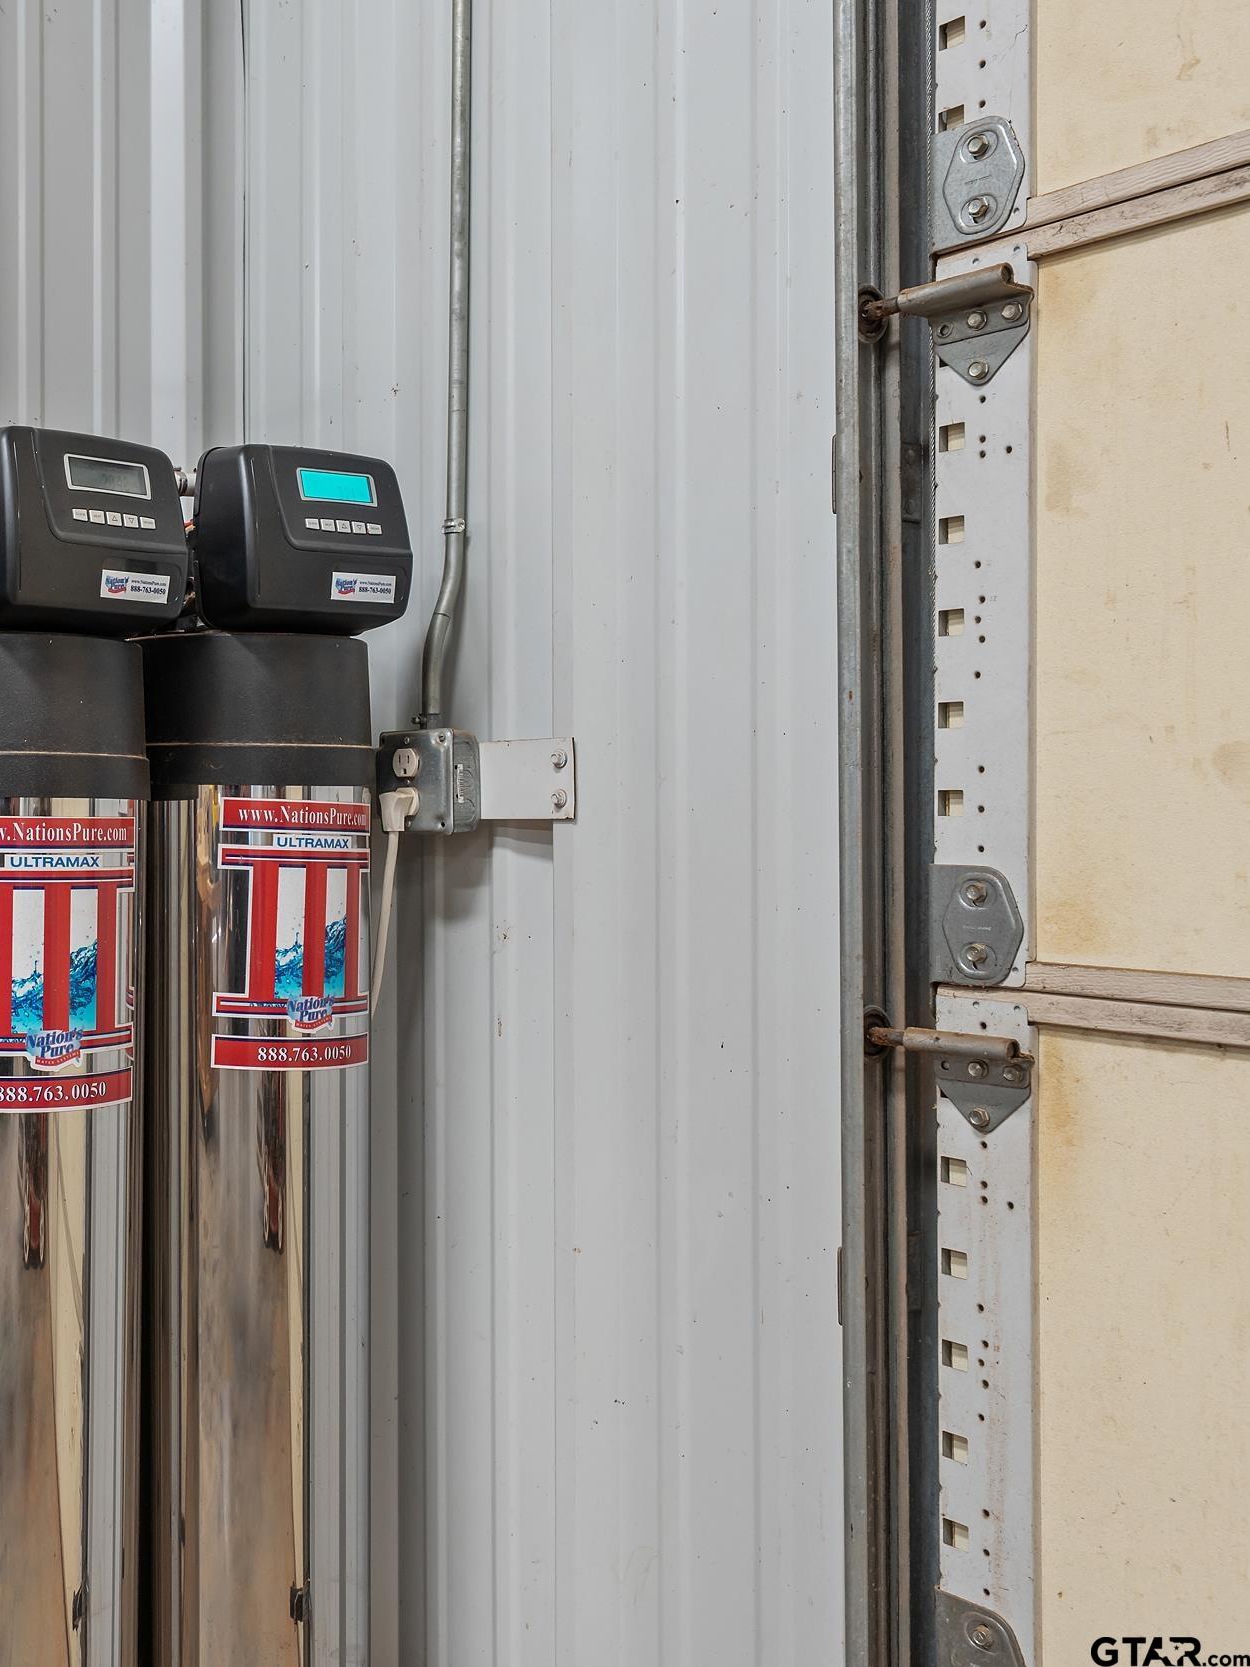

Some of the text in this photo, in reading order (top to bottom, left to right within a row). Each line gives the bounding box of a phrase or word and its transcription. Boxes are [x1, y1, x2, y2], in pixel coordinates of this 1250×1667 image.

[238, 805, 367, 826] www.NationsPure.com
[276, 836, 349, 849] ULTRAMAX
[10, 856, 100, 868] ULTRAMAX
[288, 995, 335, 1013] Nation's
[300, 1009, 327, 1021] Pure
[27, 1028, 83, 1048] Nation's
[40, 1043, 74, 1058] Pure
[257, 1045, 351, 1062] 888.763.0050
